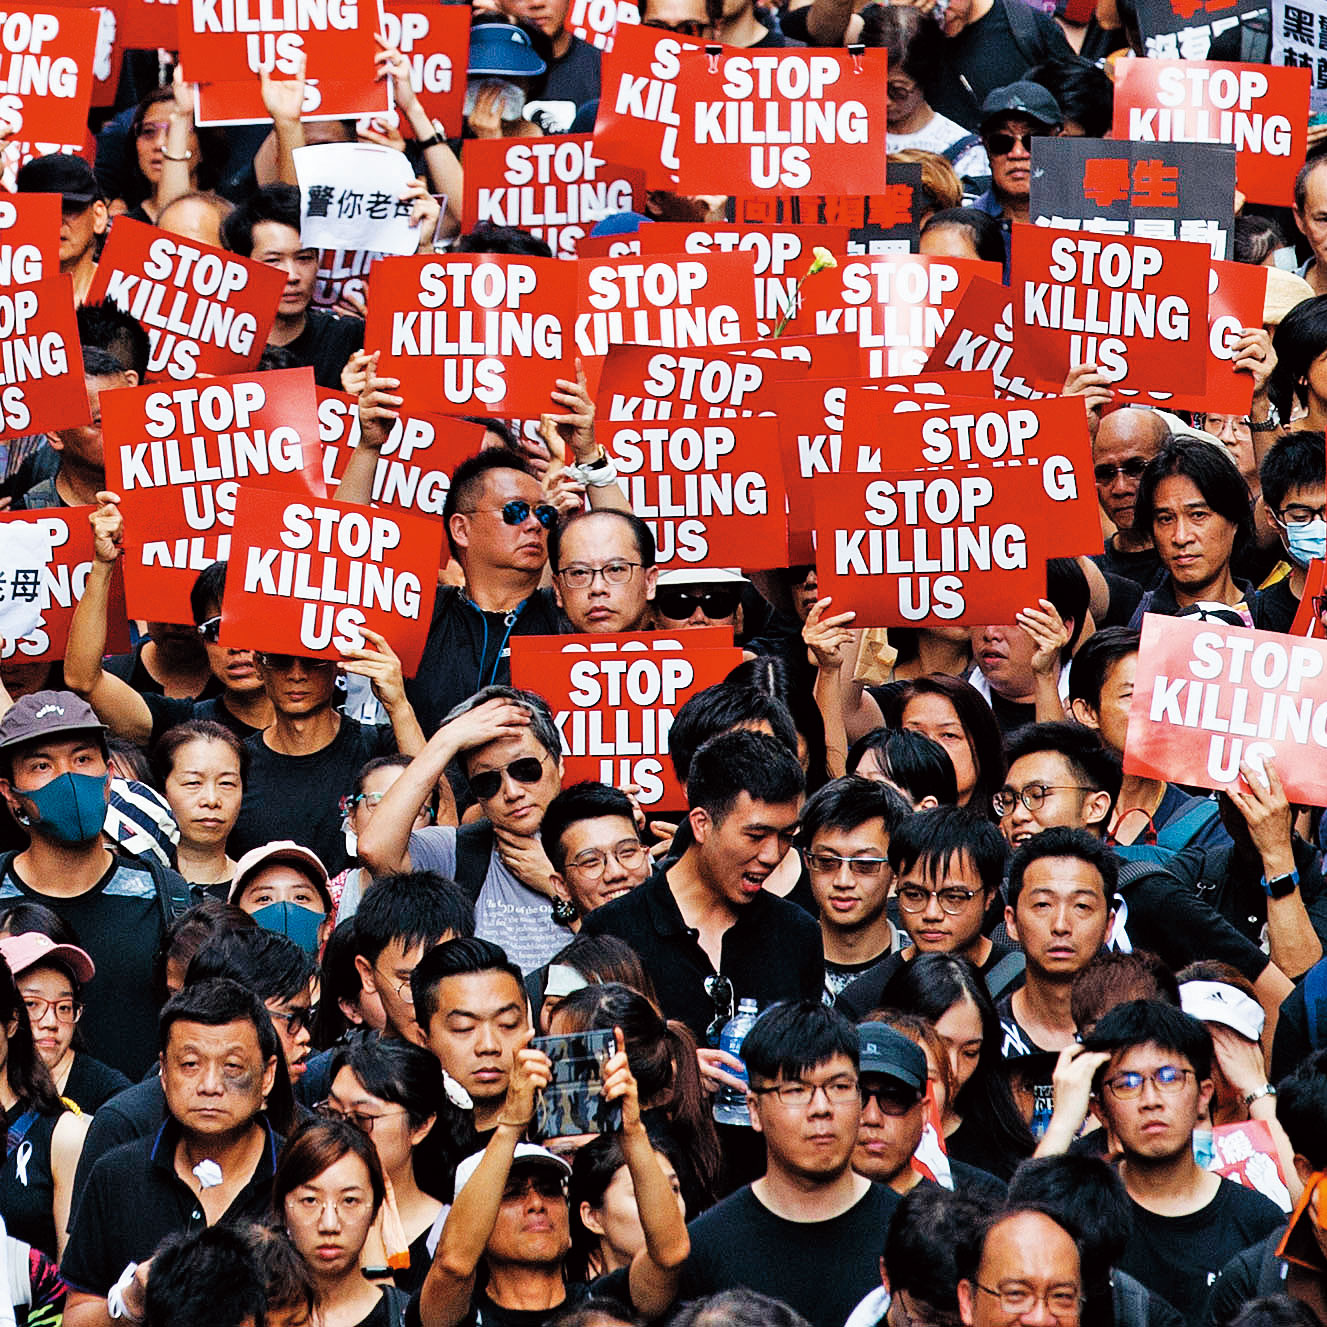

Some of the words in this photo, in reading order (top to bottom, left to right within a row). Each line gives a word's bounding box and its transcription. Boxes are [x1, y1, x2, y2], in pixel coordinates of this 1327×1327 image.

[246, 33, 305, 74] US
[723, 55, 840, 99] STOP
[694, 100, 868, 145] KILLING
[750, 145, 812, 189] US
[1084, 159, 1178, 207] 學生
[143, 237, 248, 300] STOP
[418, 263, 537, 309] STOP
[1049, 238, 1162, 290] STOP
[106, 270, 258, 358] KILLING
[391, 310, 563, 357] KILLING
[1024, 282, 1190, 341] KILLING
[148, 328, 200, 380] US
[1069, 335, 1128, 383] US
[443, 358, 506, 403] US
[865, 476, 993, 525] STOP
[281, 504, 401, 565] STOP
[834, 525, 1027, 575] KILLING
[244, 548, 422, 619] KILLING
[897, 576, 965, 620] US
[300, 602, 366, 653] US
[1189, 631, 1323, 697] STOP
[1206, 731, 1277, 784] US
